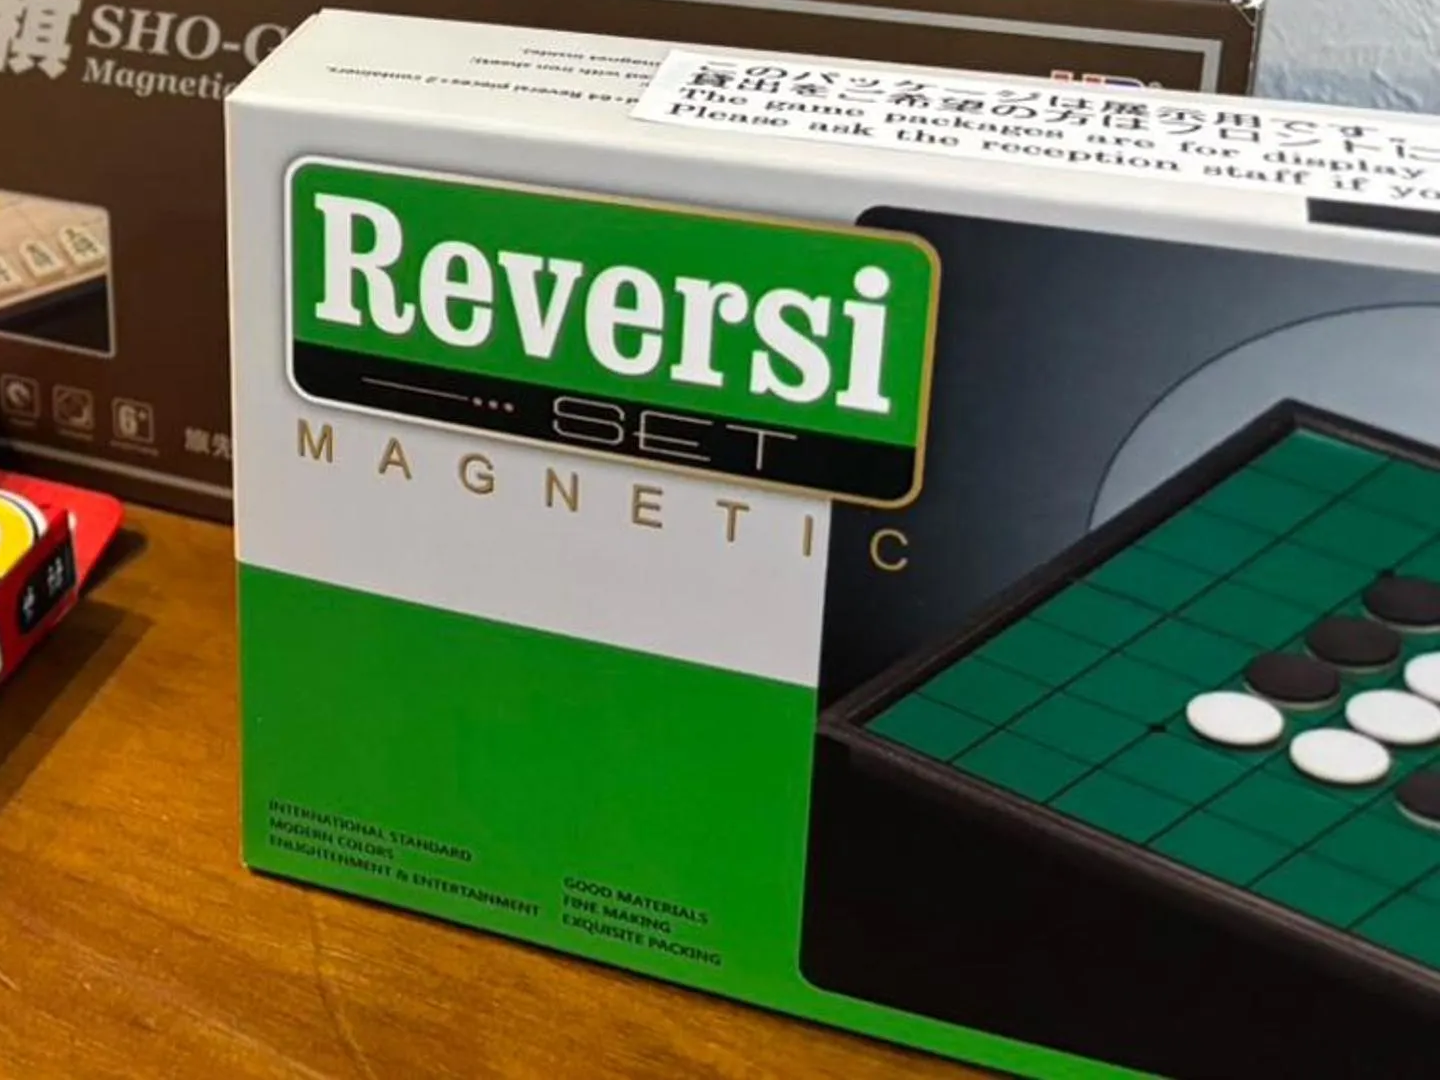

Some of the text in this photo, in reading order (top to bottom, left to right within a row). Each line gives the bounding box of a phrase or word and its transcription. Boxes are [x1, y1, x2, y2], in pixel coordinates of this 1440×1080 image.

[667, 103, 790, 128] Please
[808, 120, 874, 137] ask
[896, 128, 960, 148] the
[981, 137, 1181, 172] reception
[1202, 162, 1309, 187] staff
[1332, 174, 1371, 193] if
[679, 85, 1426, 181] The game packages are for display
[314, 192, 891, 415] Reversi
[552, 395, 797, 470] SET
[298, 418, 909, 572] MAGNETIC
[268, 799, 473, 864] INTERNATIONAL STANDARD
[268, 816, 395, 861] MODERN COLORS
[268, 834, 392, 879] ENLIGHTENMENT
[413, 872, 541, 918] ENTERTAINMENT
[563, 875, 709, 925] GOOD MATERIALS
[562, 913, 723, 967] EXQUISITE PACKING
[563, 893, 672, 935] FINE MAKING
